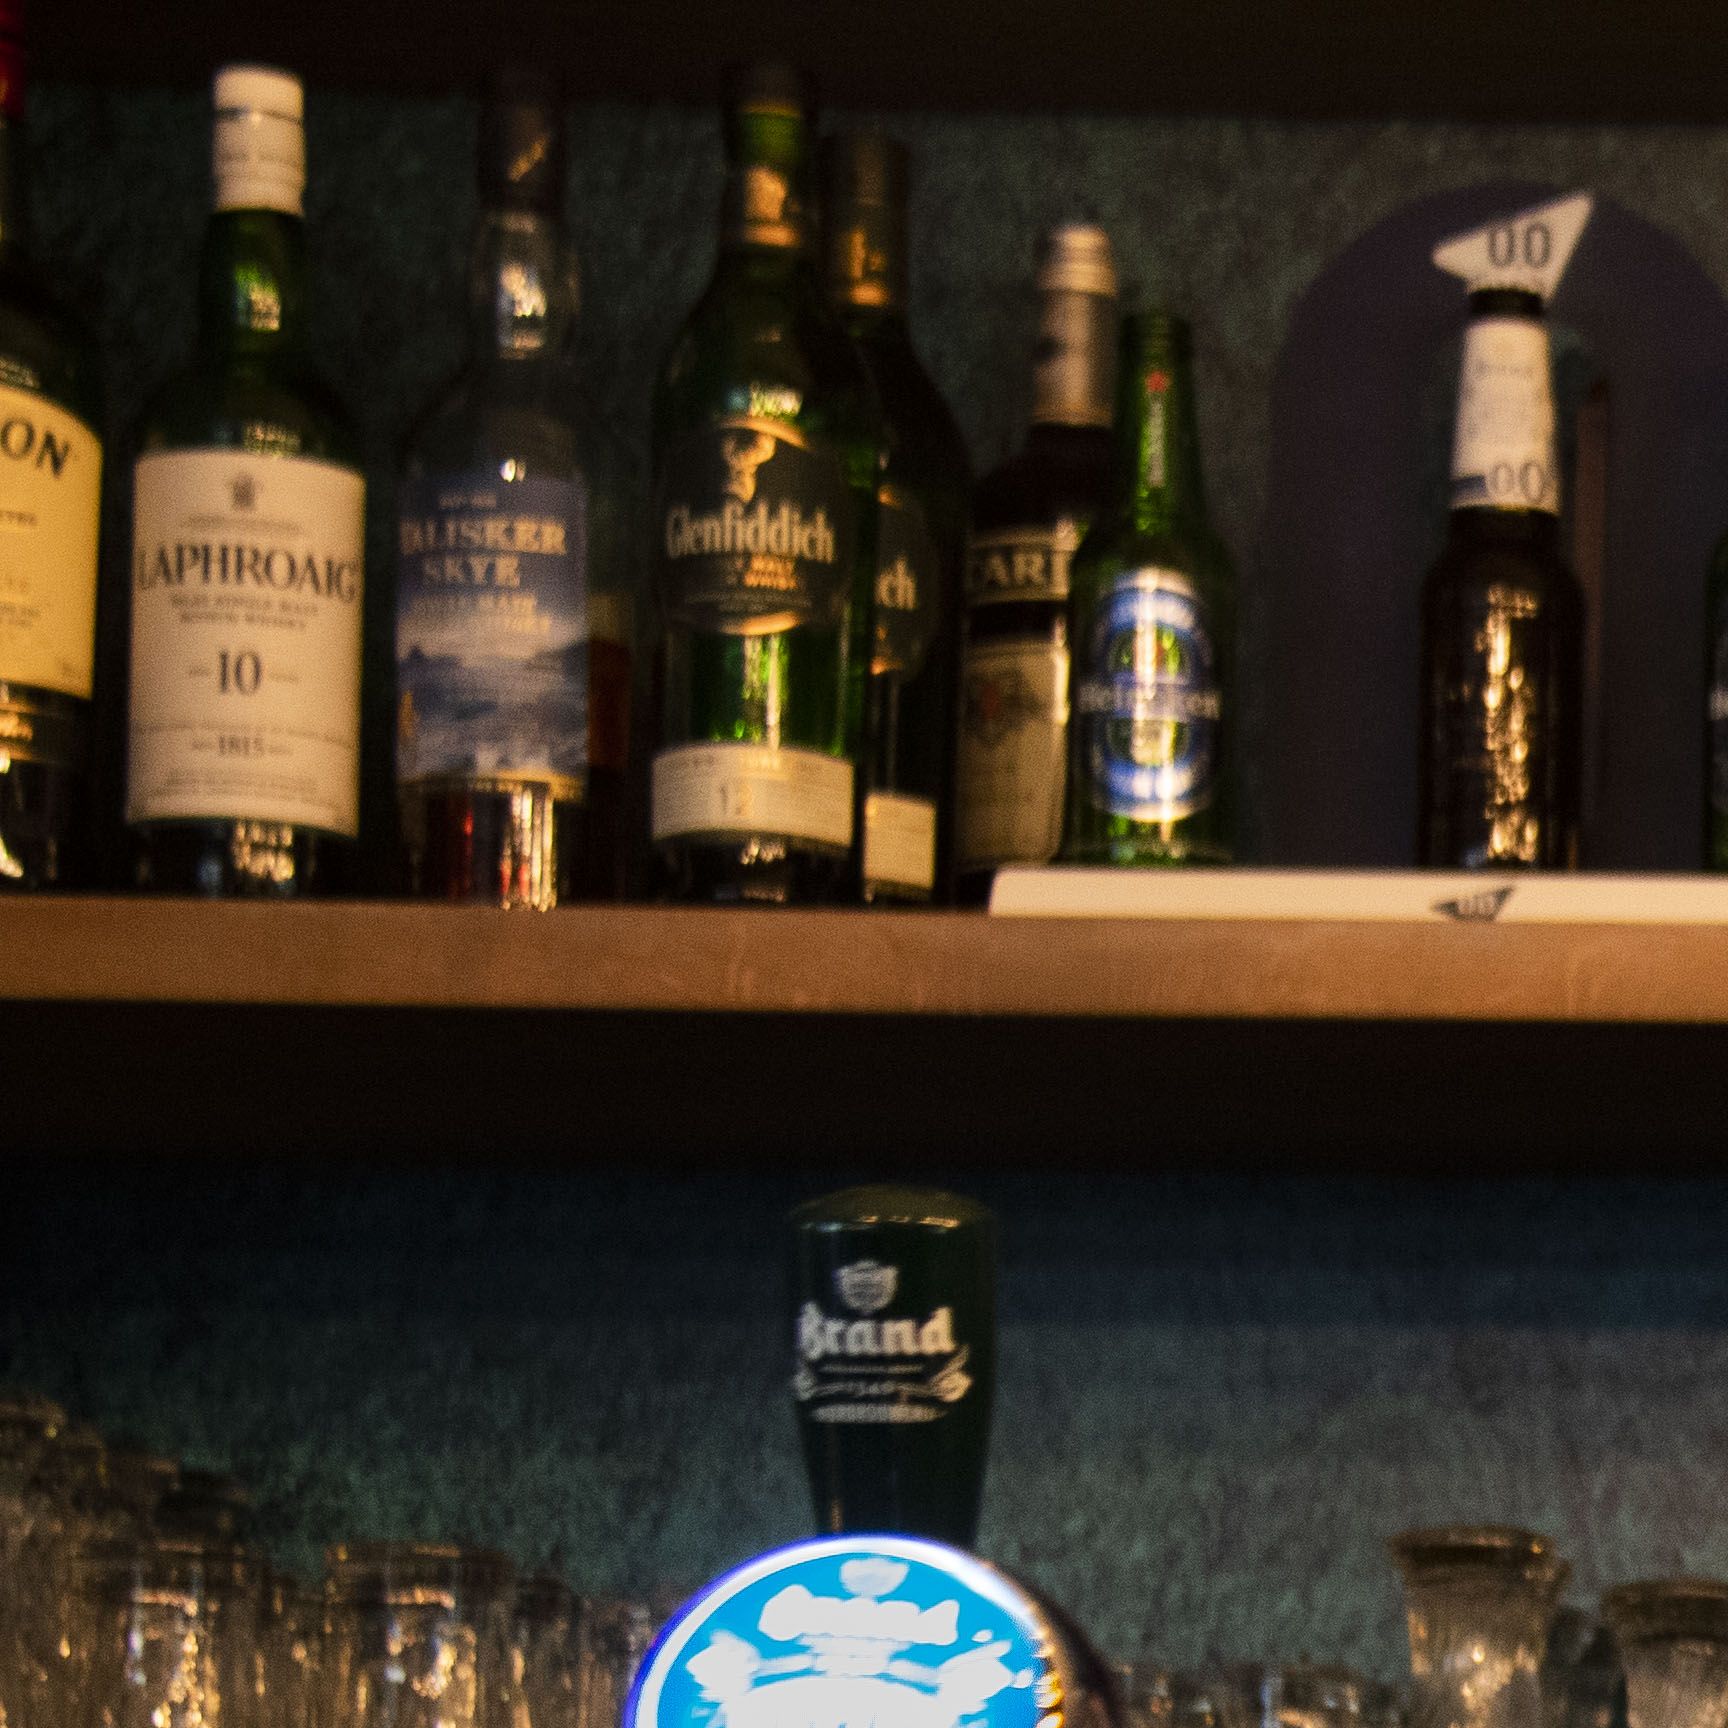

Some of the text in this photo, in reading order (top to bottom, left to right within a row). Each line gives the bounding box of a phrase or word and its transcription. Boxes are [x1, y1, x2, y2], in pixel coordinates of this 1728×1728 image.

[666, 501, 836, 564] Glenfiddich
[217, 649, 263, 696] 10
[798, 1300, 957, 1361] Brand
